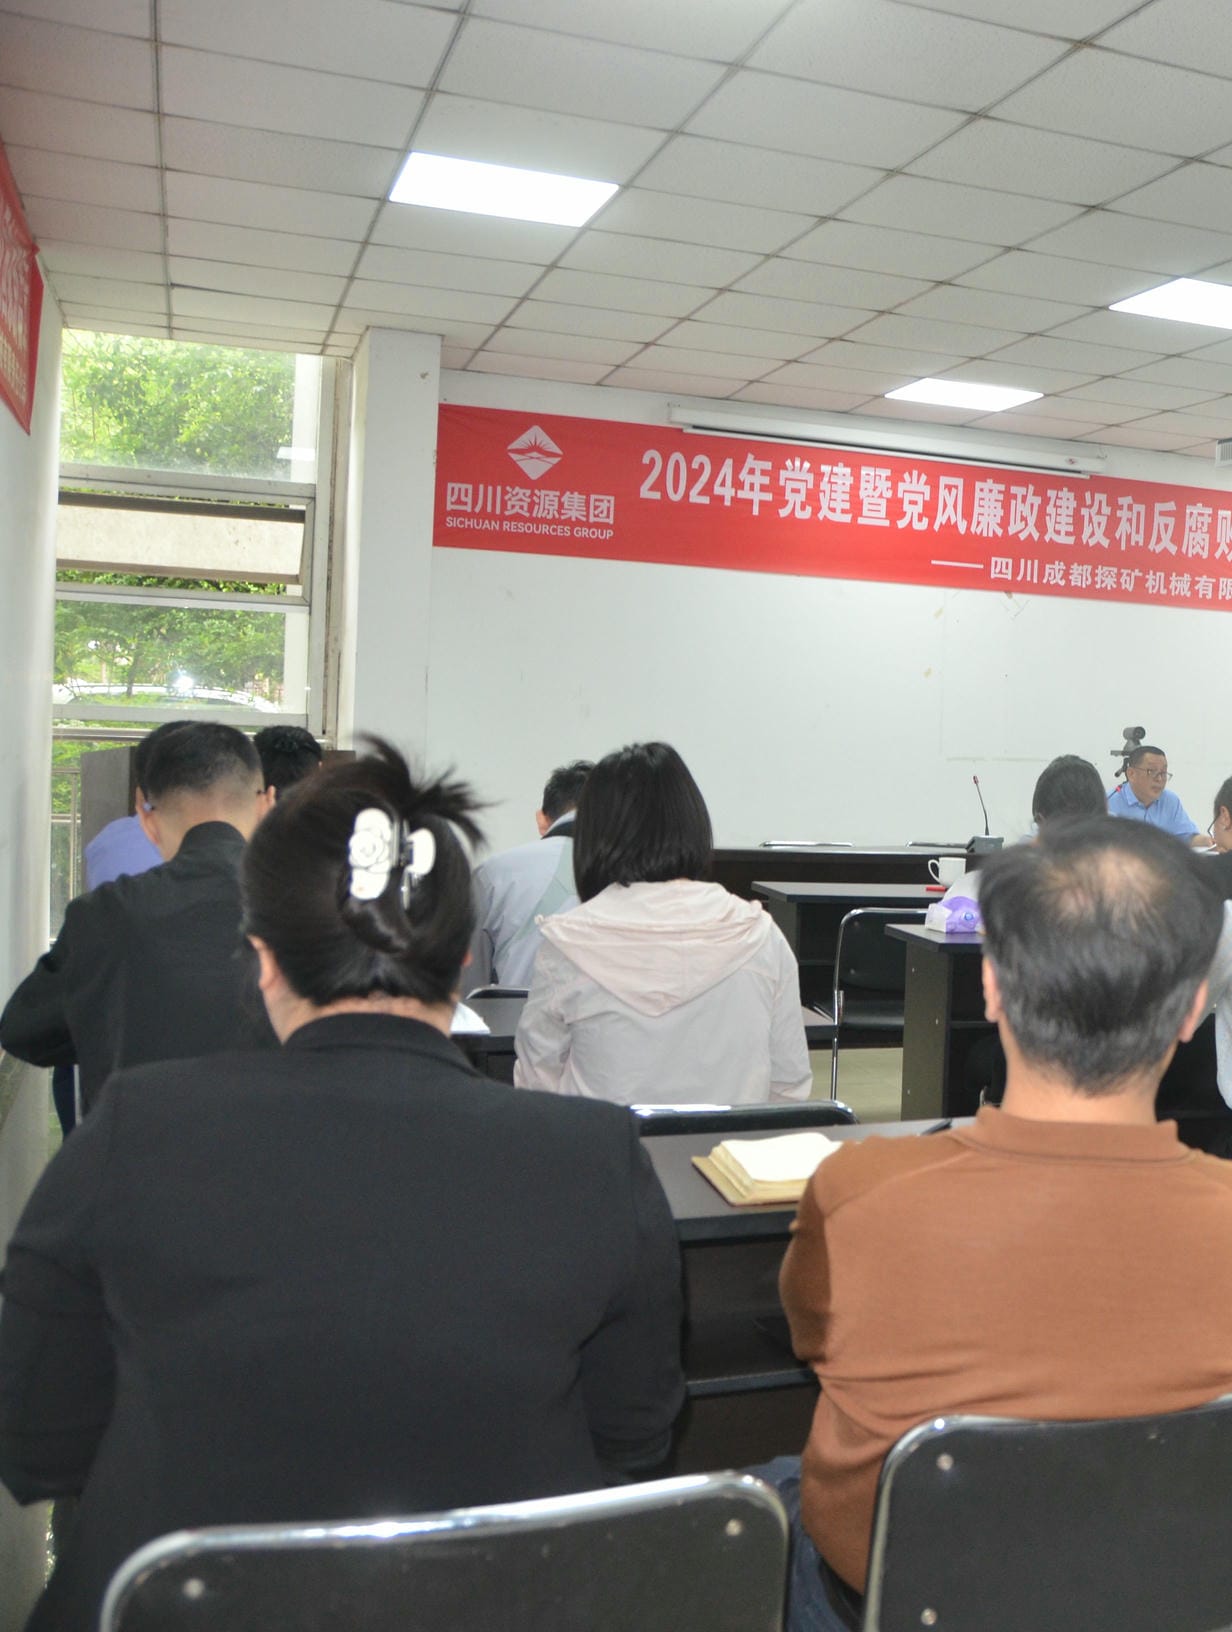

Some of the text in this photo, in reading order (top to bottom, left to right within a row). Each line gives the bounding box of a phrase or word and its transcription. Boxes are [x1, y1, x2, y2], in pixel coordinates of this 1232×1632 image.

[446, 482, 616, 525] 四川资源集团
[446, 516, 614, 540] SICHUAN RESOURCES GROUP
